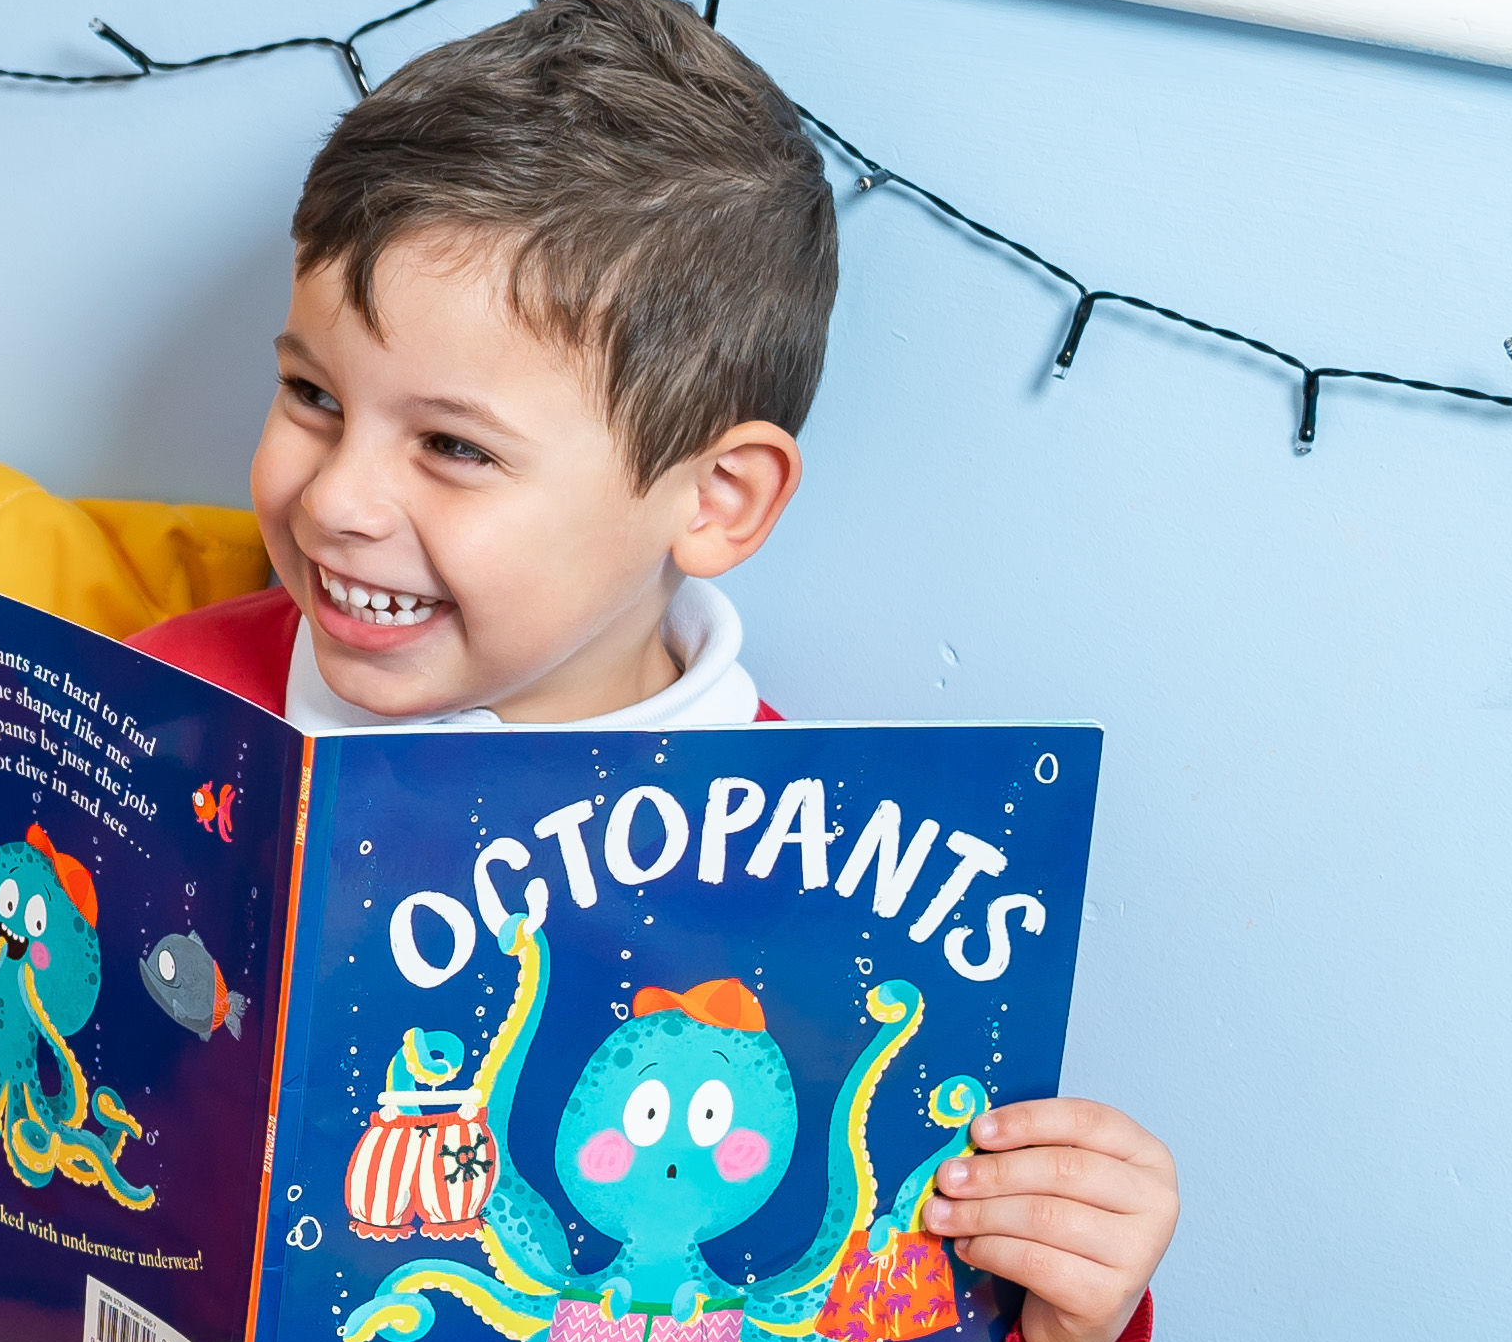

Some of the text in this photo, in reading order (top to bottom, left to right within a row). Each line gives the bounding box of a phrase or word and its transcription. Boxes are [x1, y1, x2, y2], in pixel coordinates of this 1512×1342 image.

[15, 687, 72, 729] shaped
[72, 714, 103, 750] like
[106, 741, 133, 774] me.
[34, 663, 60, 688] are
[62, 673, 101, 712] hard
[102, 702, 119, 726] to
[120, 715, 157, 757] find
[15, 756, 48, 785] dive
[52, 770, 67, 797] in
[71, 790, 100, 818] and
[102, 811, 128, 838] see
[388, 775, 1047, 989] OCTOPANTS
[27, 1218, 58, 1244] with
[60, 1231, 136, 1265] underwater
[137, 1250, 204, 1271] underwear!
